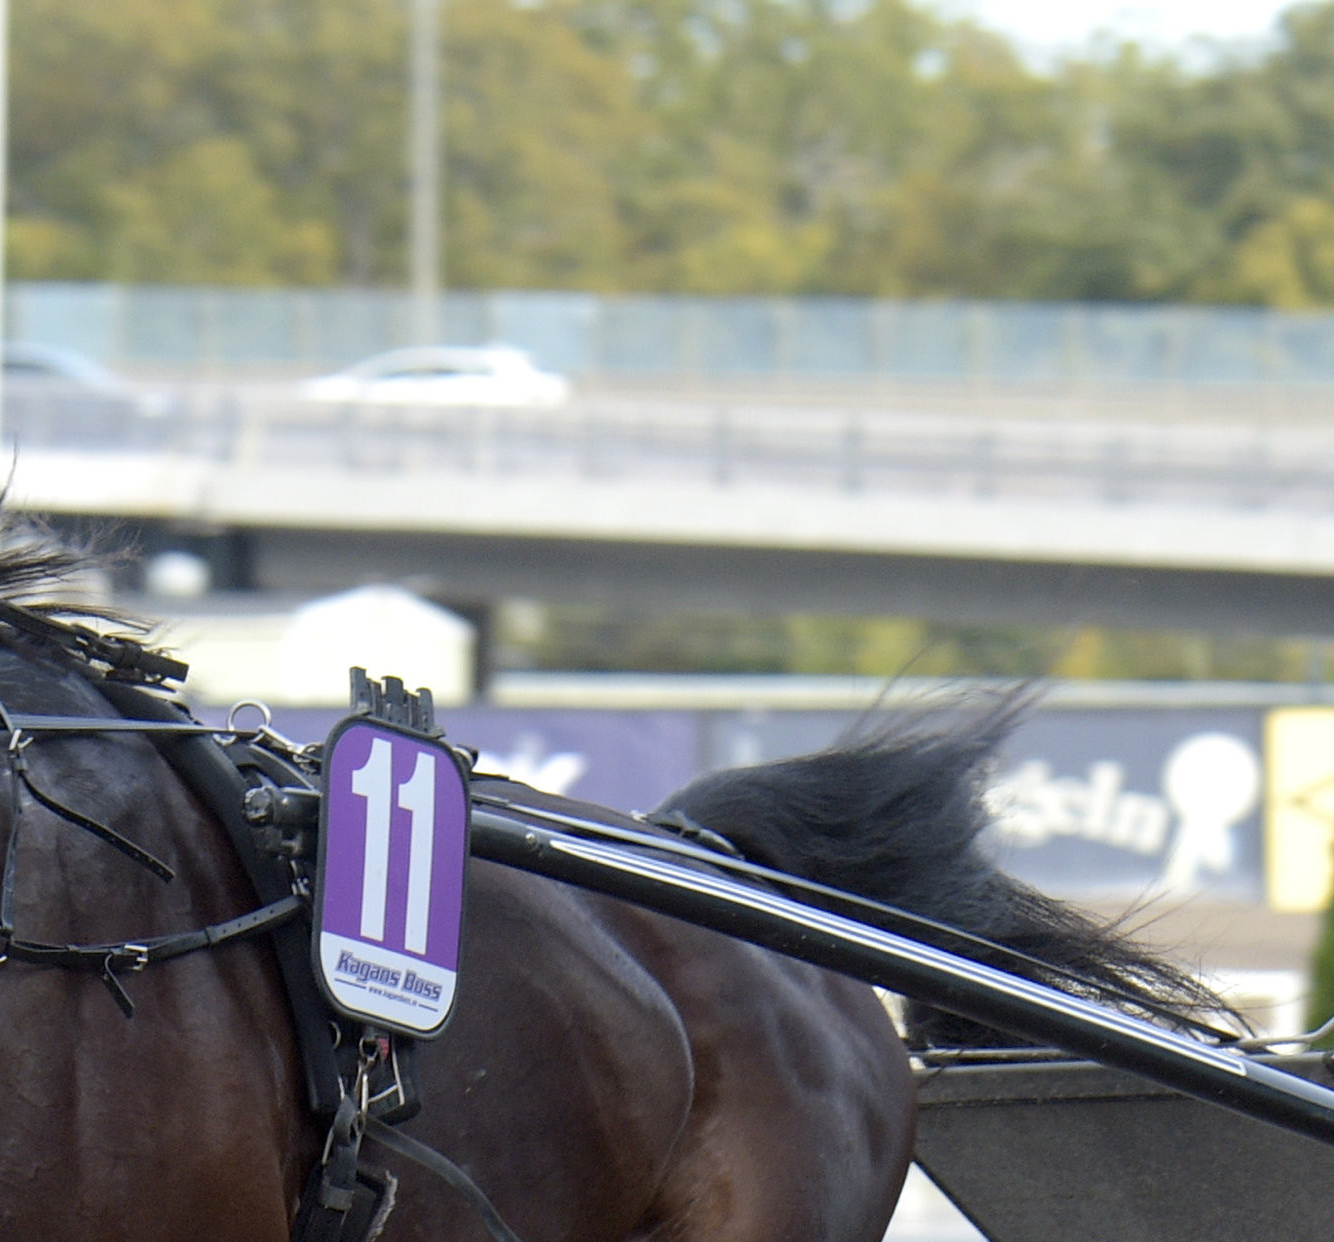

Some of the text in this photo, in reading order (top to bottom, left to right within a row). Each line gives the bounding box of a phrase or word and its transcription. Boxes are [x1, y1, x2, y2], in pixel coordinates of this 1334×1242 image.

[352, 737, 436, 956] 11
[334, 949, 403, 990] Kagans
[401, 969, 443, 1003] Buss
